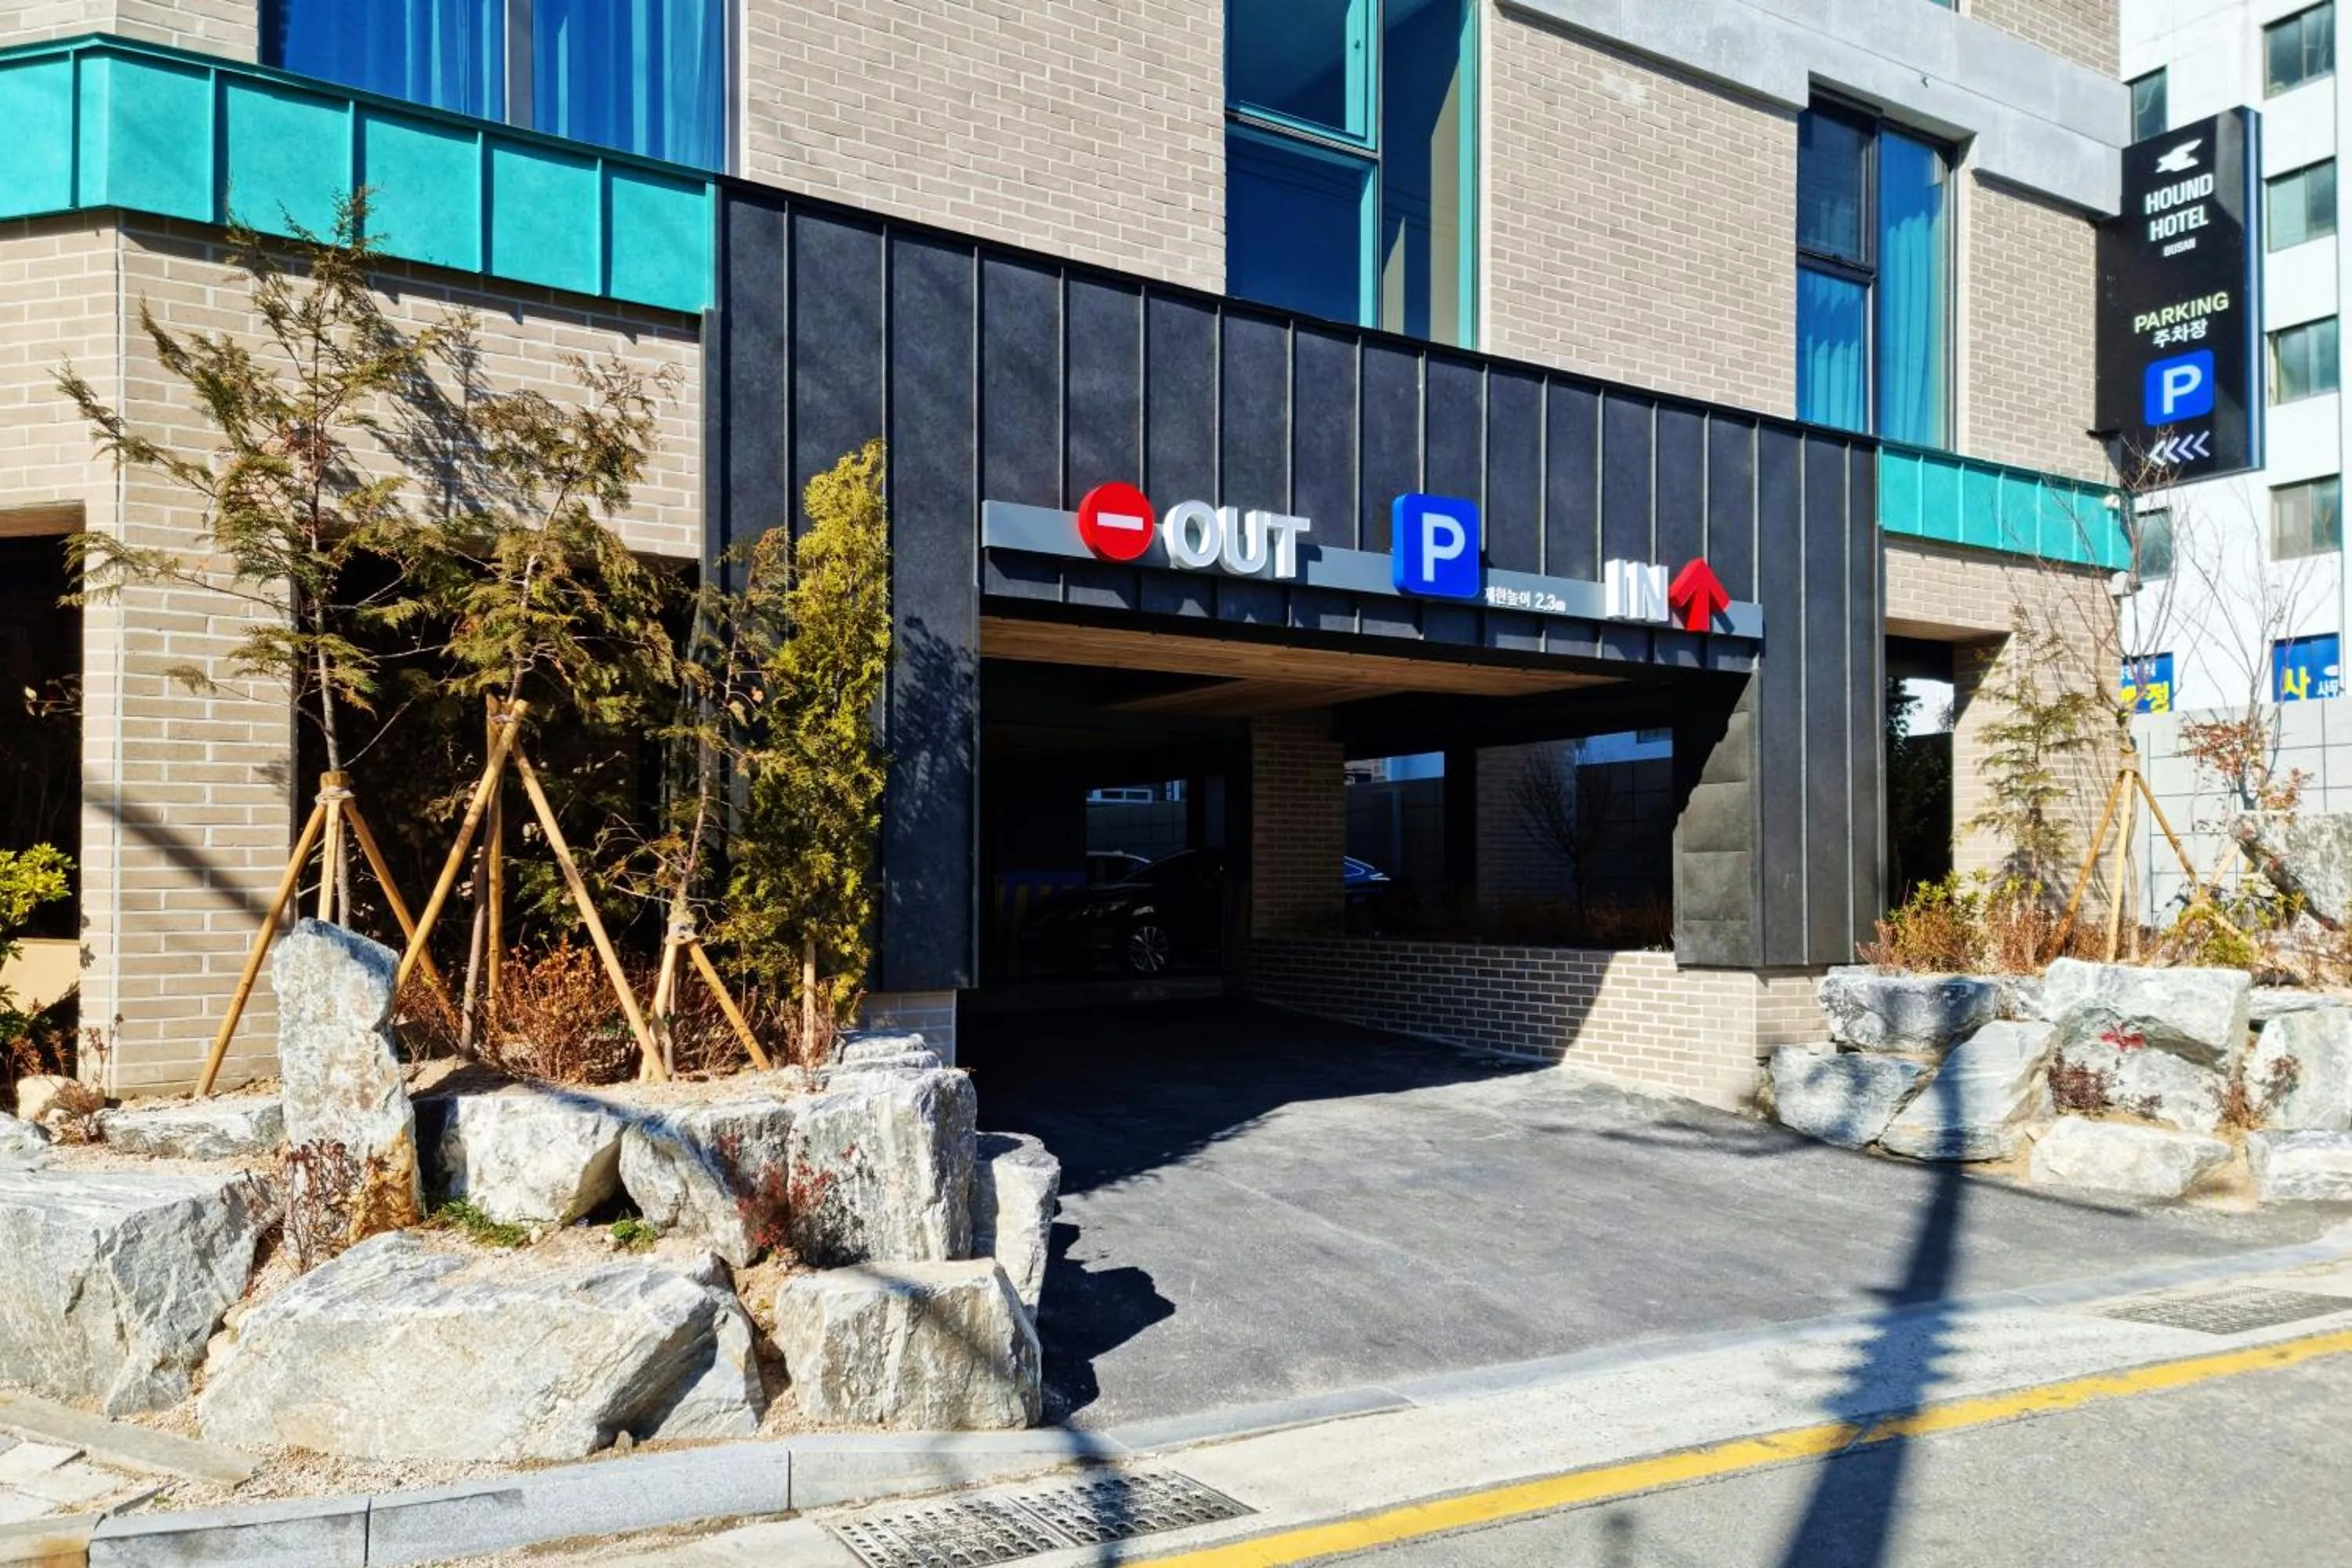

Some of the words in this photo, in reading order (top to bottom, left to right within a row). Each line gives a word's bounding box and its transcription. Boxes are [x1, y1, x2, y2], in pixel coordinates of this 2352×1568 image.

[2145, 172, 2213, 215] HOUND
[2149, 205, 2209, 242] HOTEL
[2133, 291, 2230, 334] PARKING
[2152, 318, 2209, 348] 주차장
[2163, 364, 2202, 415] P
[1163, 500, 1311, 579] OUT
[1421, 512, 1466, 583] P
[1605, 557, 1669, 622] IN
